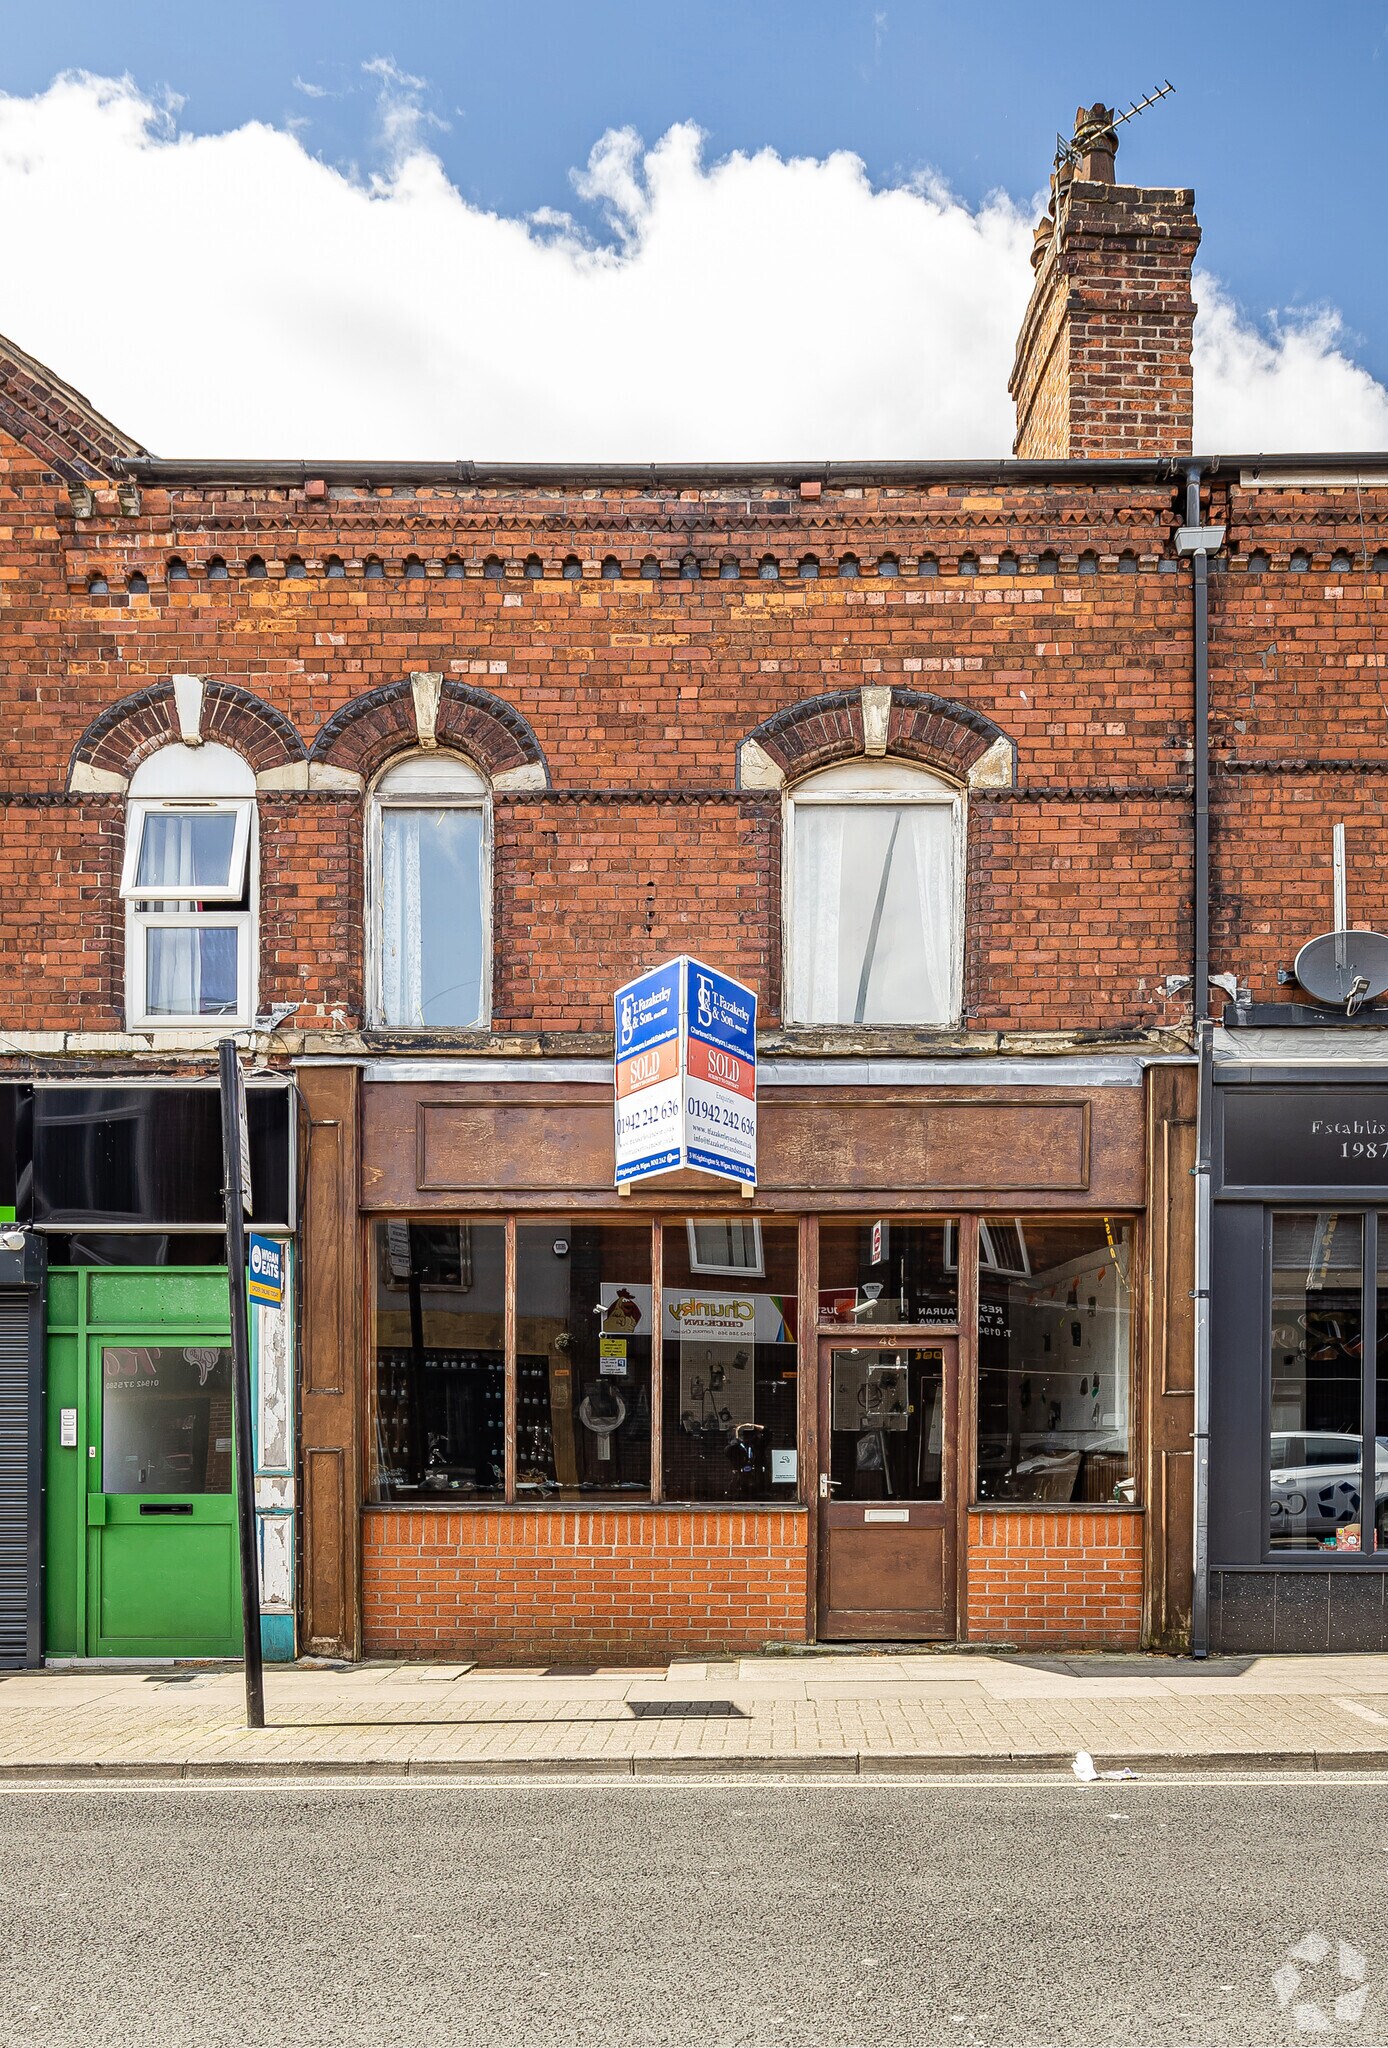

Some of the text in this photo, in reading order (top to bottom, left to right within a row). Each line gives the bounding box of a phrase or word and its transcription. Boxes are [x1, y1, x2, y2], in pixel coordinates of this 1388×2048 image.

[712, 1006, 720, 1020] &
[719, 995, 750, 1024] Fazakerley
[632, 1016, 639, 1029] &
[630, 1052, 660, 1084] SOLD
[708, 1050, 740, 1082] SOLD
[616, 1098, 678, 1136] 01942 242 636
[688, 1096, 754, 1136] 01942 242 636
[1312, 1120, 1388, 1134] Establis
[1340, 1142, 1388, 1158] 1987
[261, 1248, 278, 1264] WIGAN
[262, 1260, 278, 1279] EATS
[879, 1336, 897, 1346] 48
